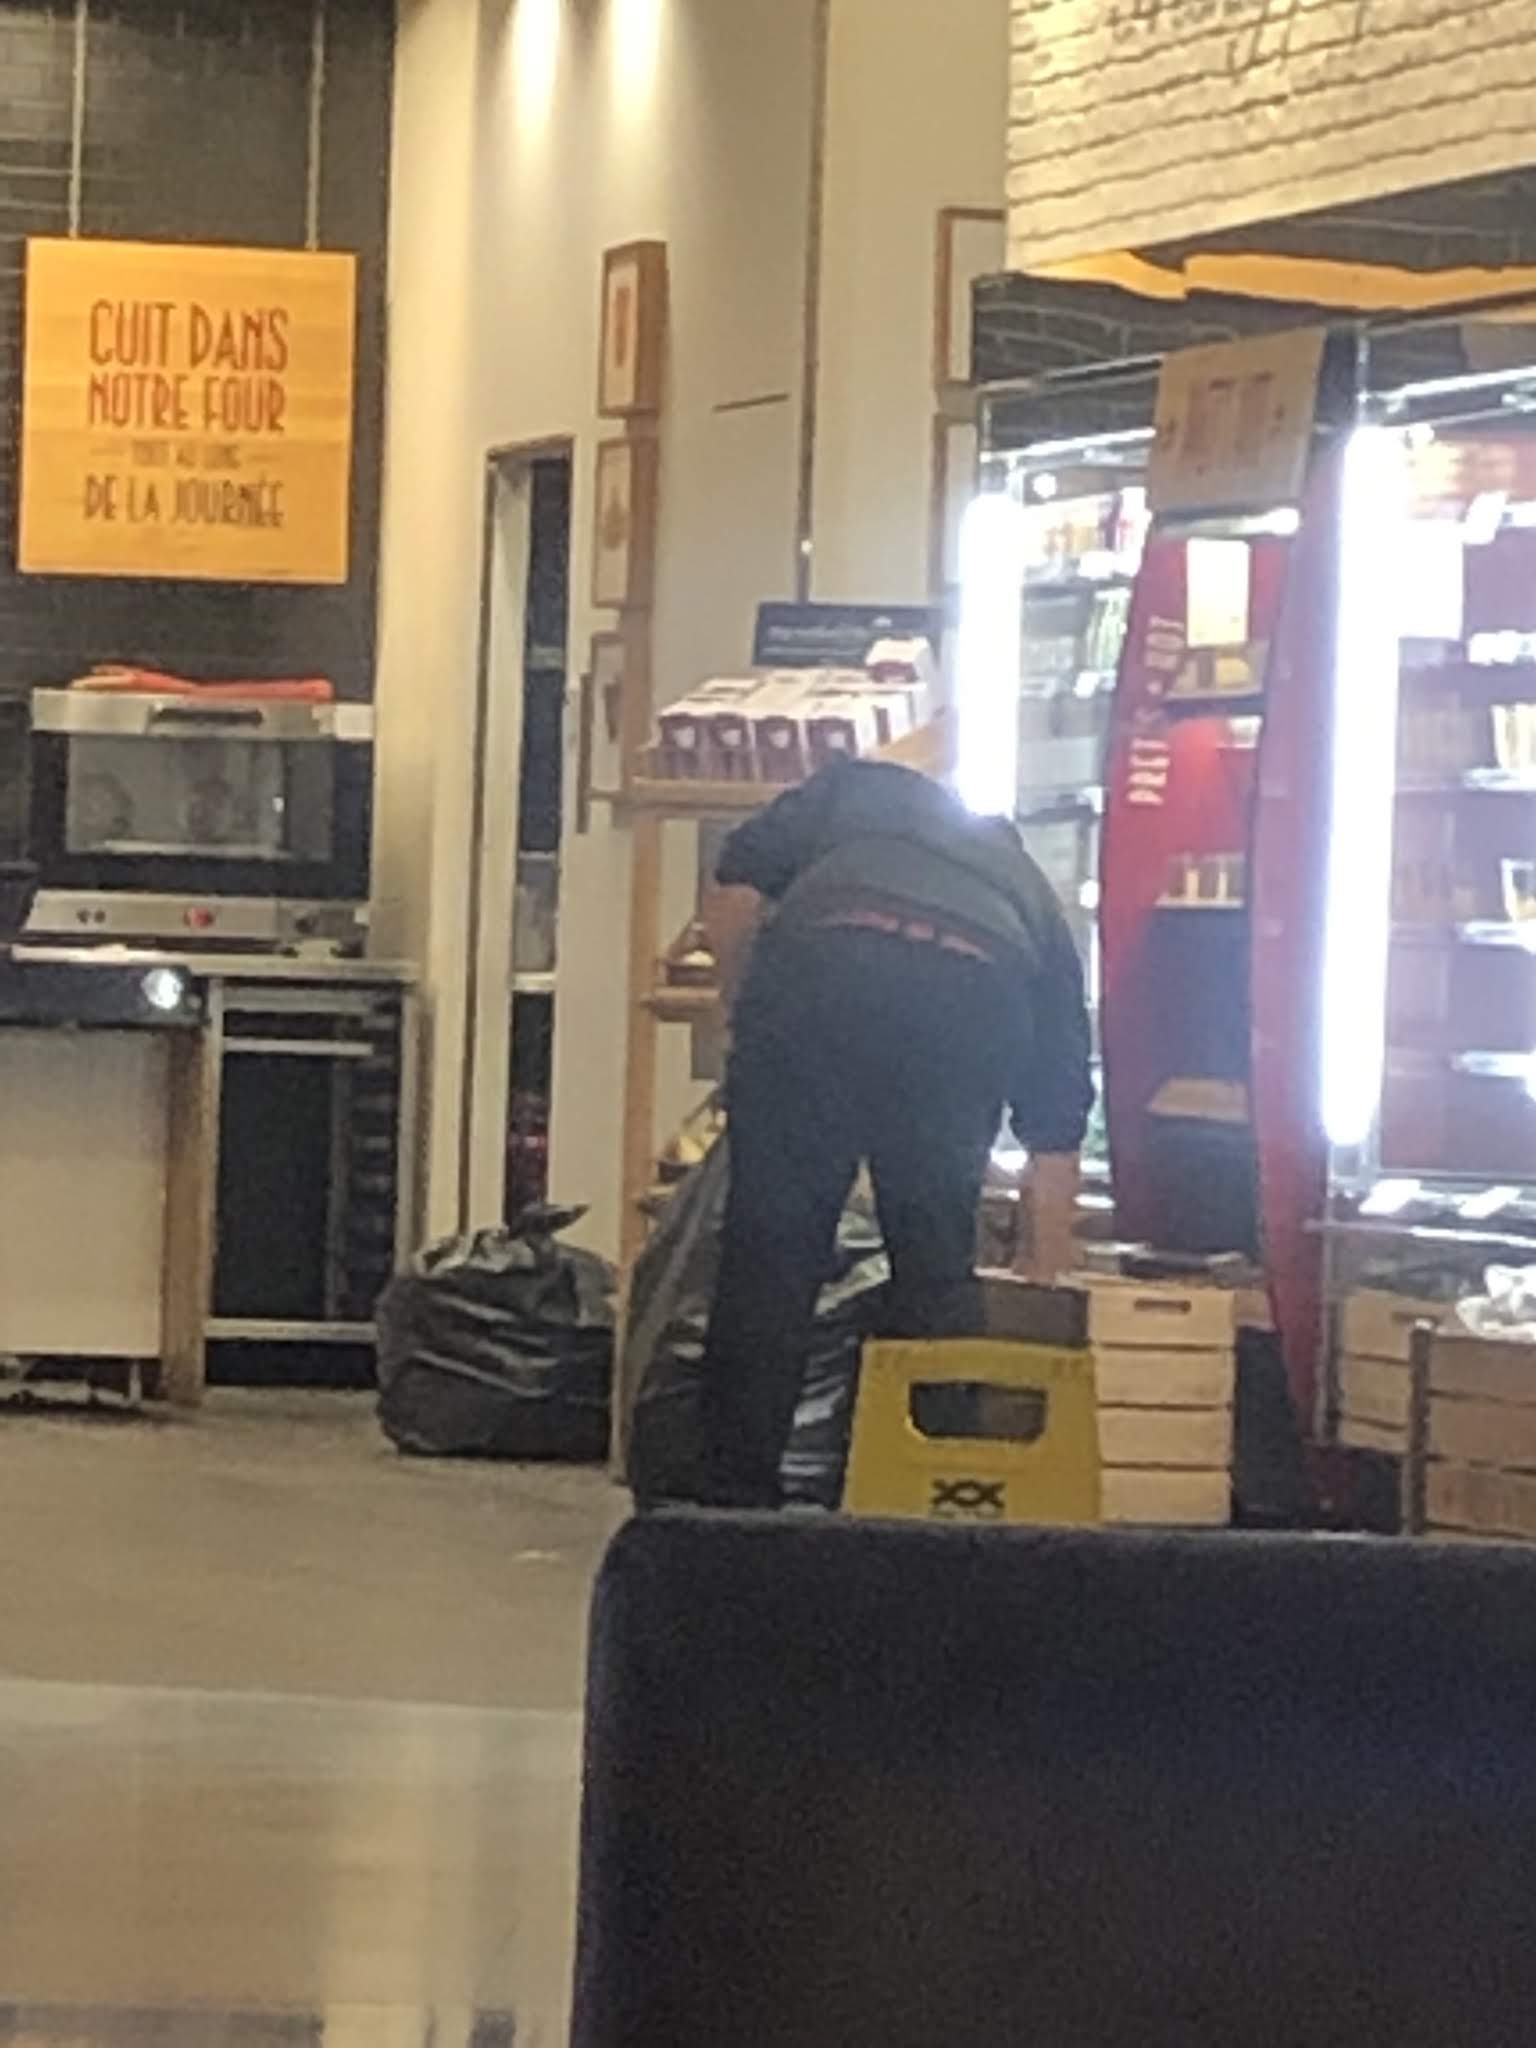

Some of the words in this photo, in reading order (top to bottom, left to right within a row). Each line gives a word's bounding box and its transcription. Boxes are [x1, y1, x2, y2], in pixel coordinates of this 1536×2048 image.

[90, 299, 177, 368] CUIT
[189, 302, 288, 371] DANS
[89, 372, 189, 430] NOTRE
[203, 375, 285, 433] FOUR
[83, 471, 118, 521] DE
[126, 475, 161, 525] LA
[169, 471, 285, 529] JOURNÉE
